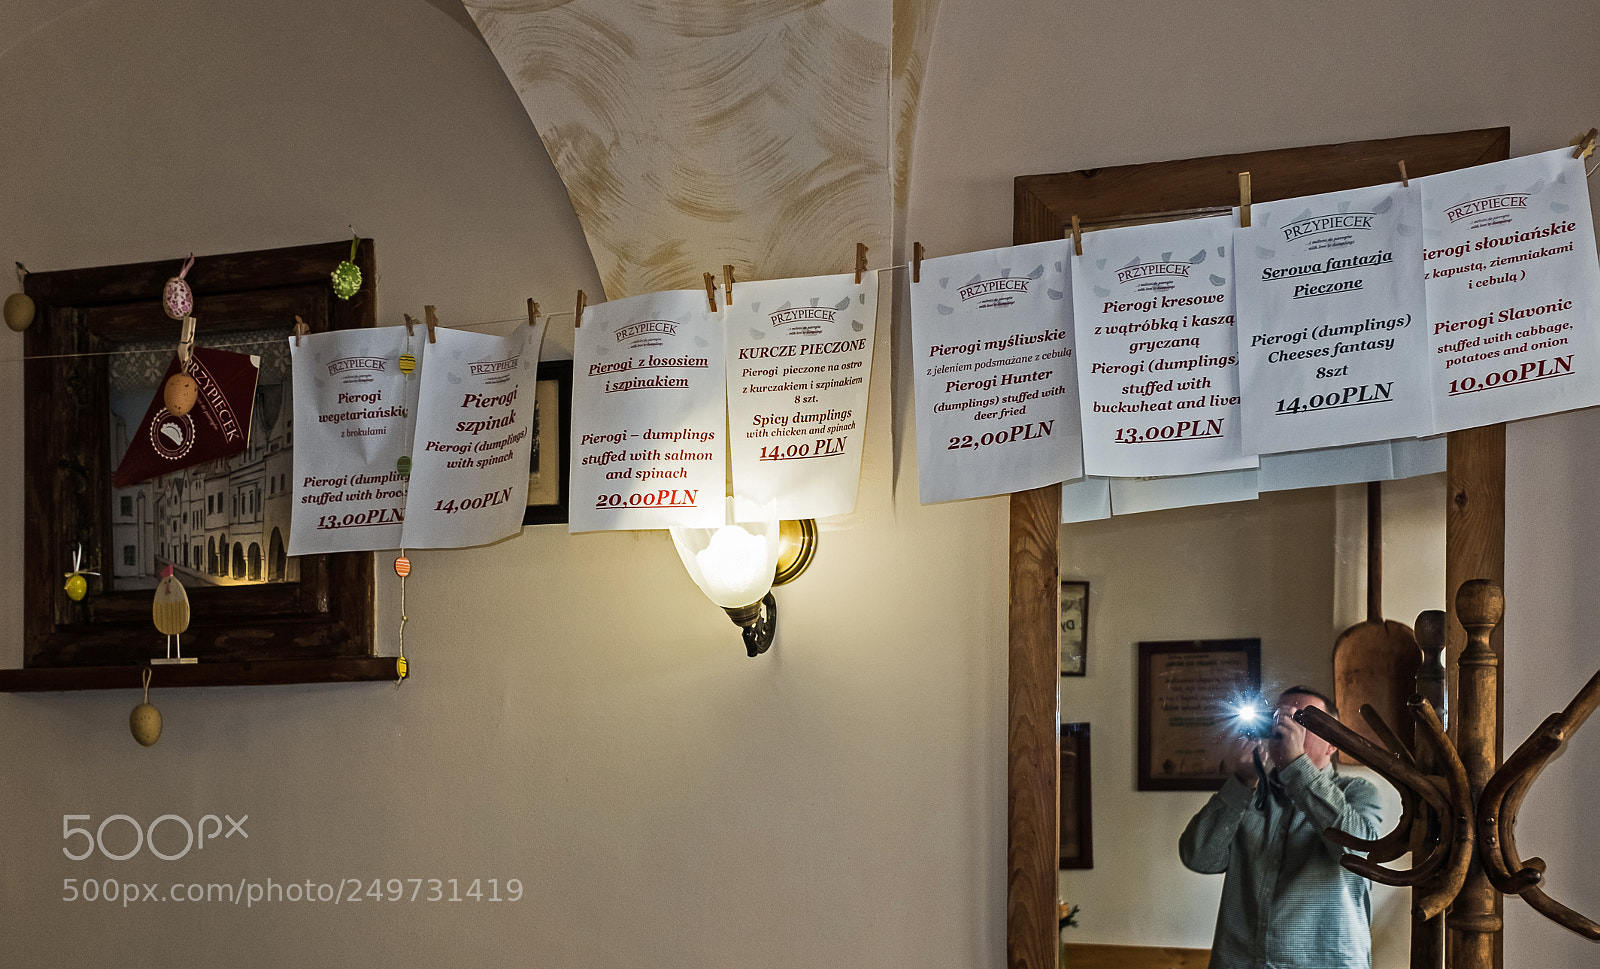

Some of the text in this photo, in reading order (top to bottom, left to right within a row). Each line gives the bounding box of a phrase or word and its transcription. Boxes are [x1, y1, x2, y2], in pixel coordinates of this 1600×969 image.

[1447, 197, 1528, 221] PRZYPIECEK
[1284, 216, 1374, 240] PRZYPIECEK
[1423, 240, 1471, 261] ierogi
[1475, 220, 1576, 250] słowiańskie
[1262, 250, 1393, 281] Serowa fantazja
[1432, 262, 1487, 279] kapustą,
[1490, 241, 1574, 268] ziemniakami
[1118, 264, 1190, 281] PRZYPIECEK
[1468, 280, 1474, 289] i
[1475, 273, 1517, 288] cebulą
[960, 280, 1029, 299] PRZYPIECEK
[1293, 277, 1363, 299] Pieczone
[1102, 293, 1224, 314] Pierogi kresowe
[771, 310, 836, 325] PRZYPIECEK
[1094, 314, 1235, 336] z wątróbką i kaszą
[1433, 298, 1574, 335] Pierogi Slavonic
[616, 323, 677, 341] PRZYPIECEK
[1251, 313, 1412, 347] Pierogi (dumplings)
[1437, 320, 1574, 354] stuffed with cabbage,
[738, 338, 866, 360] KURCZE PIECZONE
[929, 329, 1066, 357] Pierogi myśliwskie
[1129, 336, 1200, 354] gryczaną
[1268, 336, 1394, 364] Cheeses fantasy
[1445, 336, 1568, 368] potatoes and onion
[328, 359, 386, 375] PRZYPIECEK
[588, 355, 708, 376] Pierogi z łososiem
[742, 360, 862, 378] Pierogi pieczone na ostro
[926, 348, 1072, 376] z jeleniem podsmażane z cebulą
[1091, 360, 1144, 375] Pierogi
[1316, 364, 1348, 379] 8szt
[605, 376, 688, 392] i szpinakiem
[742, 376, 863, 394] z kurczakiem i szpinakiem
[945, 370, 1052, 393] Pierogi Hunter
[1449, 354, 1575, 396] 10,00PLN
[338, 390, 382, 404] Pierogi
[461, 385, 518, 408] Pierogi
[1122, 377, 1211, 397] stuffed with
[794, 394, 818, 404] 8 szt.
[933, 386, 1066, 414] (dumplings) stuffed with
[1093, 398, 1172, 413] buckwheat
[1176, 396, 1206, 408] and
[1276, 381, 1394, 415] 14,00PLN
[456, 410, 516, 435] szpinak
[753, 409, 852, 428] Spicy dumplings
[974, 406, 1026, 421] deer fried
[341, 429, 346, 438] z
[581, 429, 627, 445] Pierogi
[643, 429, 715, 442] dumplings
[746, 421, 856, 438] with chicken and spinach
[948, 420, 1055, 450] 22,00PLN
[1115, 418, 1224, 444] 13,00PLN
[425, 426, 528, 455] Pierogi (dumplings)
[760, 436, 848, 461] 14,00 PLN
[446, 450, 514, 470] with spinach
[582, 449, 713, 466] stuffed with salmon
[303, 475, 348, 488] Pierogi
[606, 467, 688, 481] and spinach
[302, 491, 343, 505] stuffed
[346, 490, 372, 501] with
[434, 487, 512, 514] 14,00PLN
[596, 489, 699, 510] 20,00PLN
